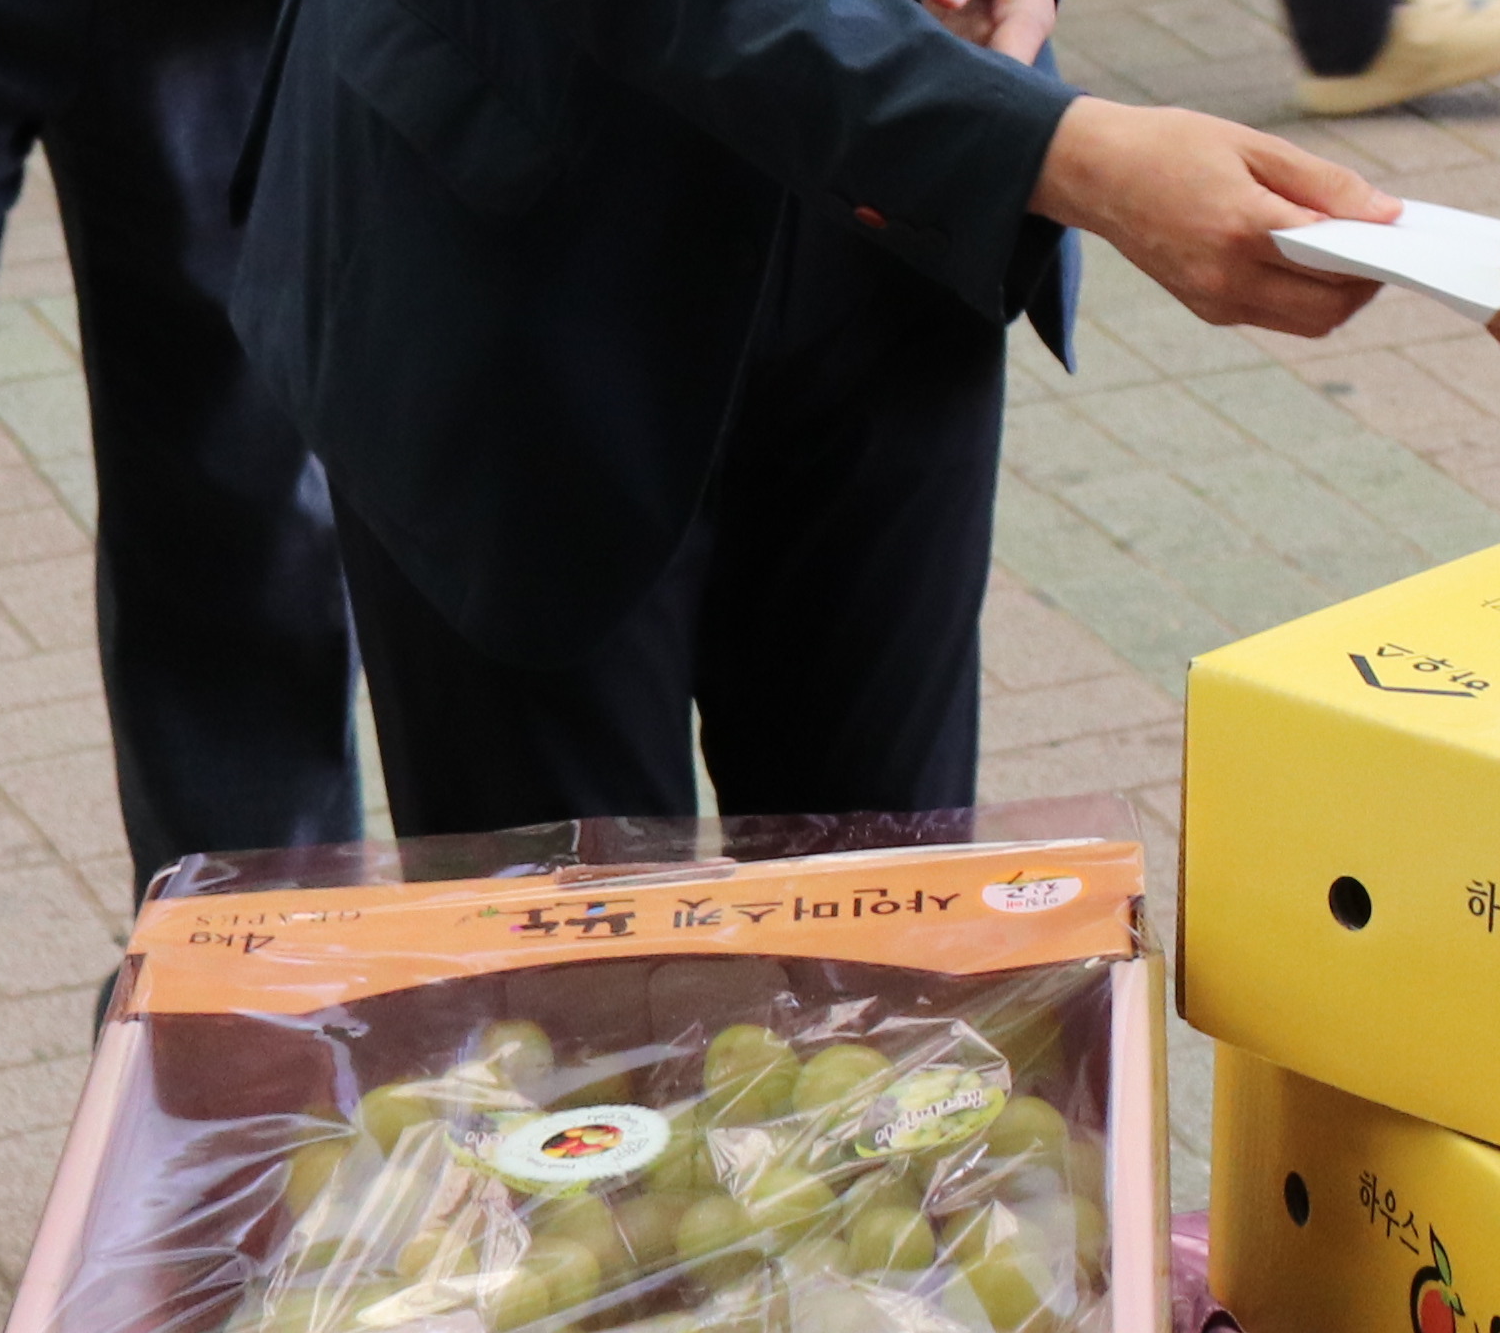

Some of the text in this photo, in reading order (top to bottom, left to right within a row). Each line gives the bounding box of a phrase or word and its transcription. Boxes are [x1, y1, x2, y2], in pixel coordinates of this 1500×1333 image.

[672, 888, 960, 931] 샤인머스켓
[188, 932, 276, 954] 4kg
[1357, 1171, 1422, 1256] 하우스
